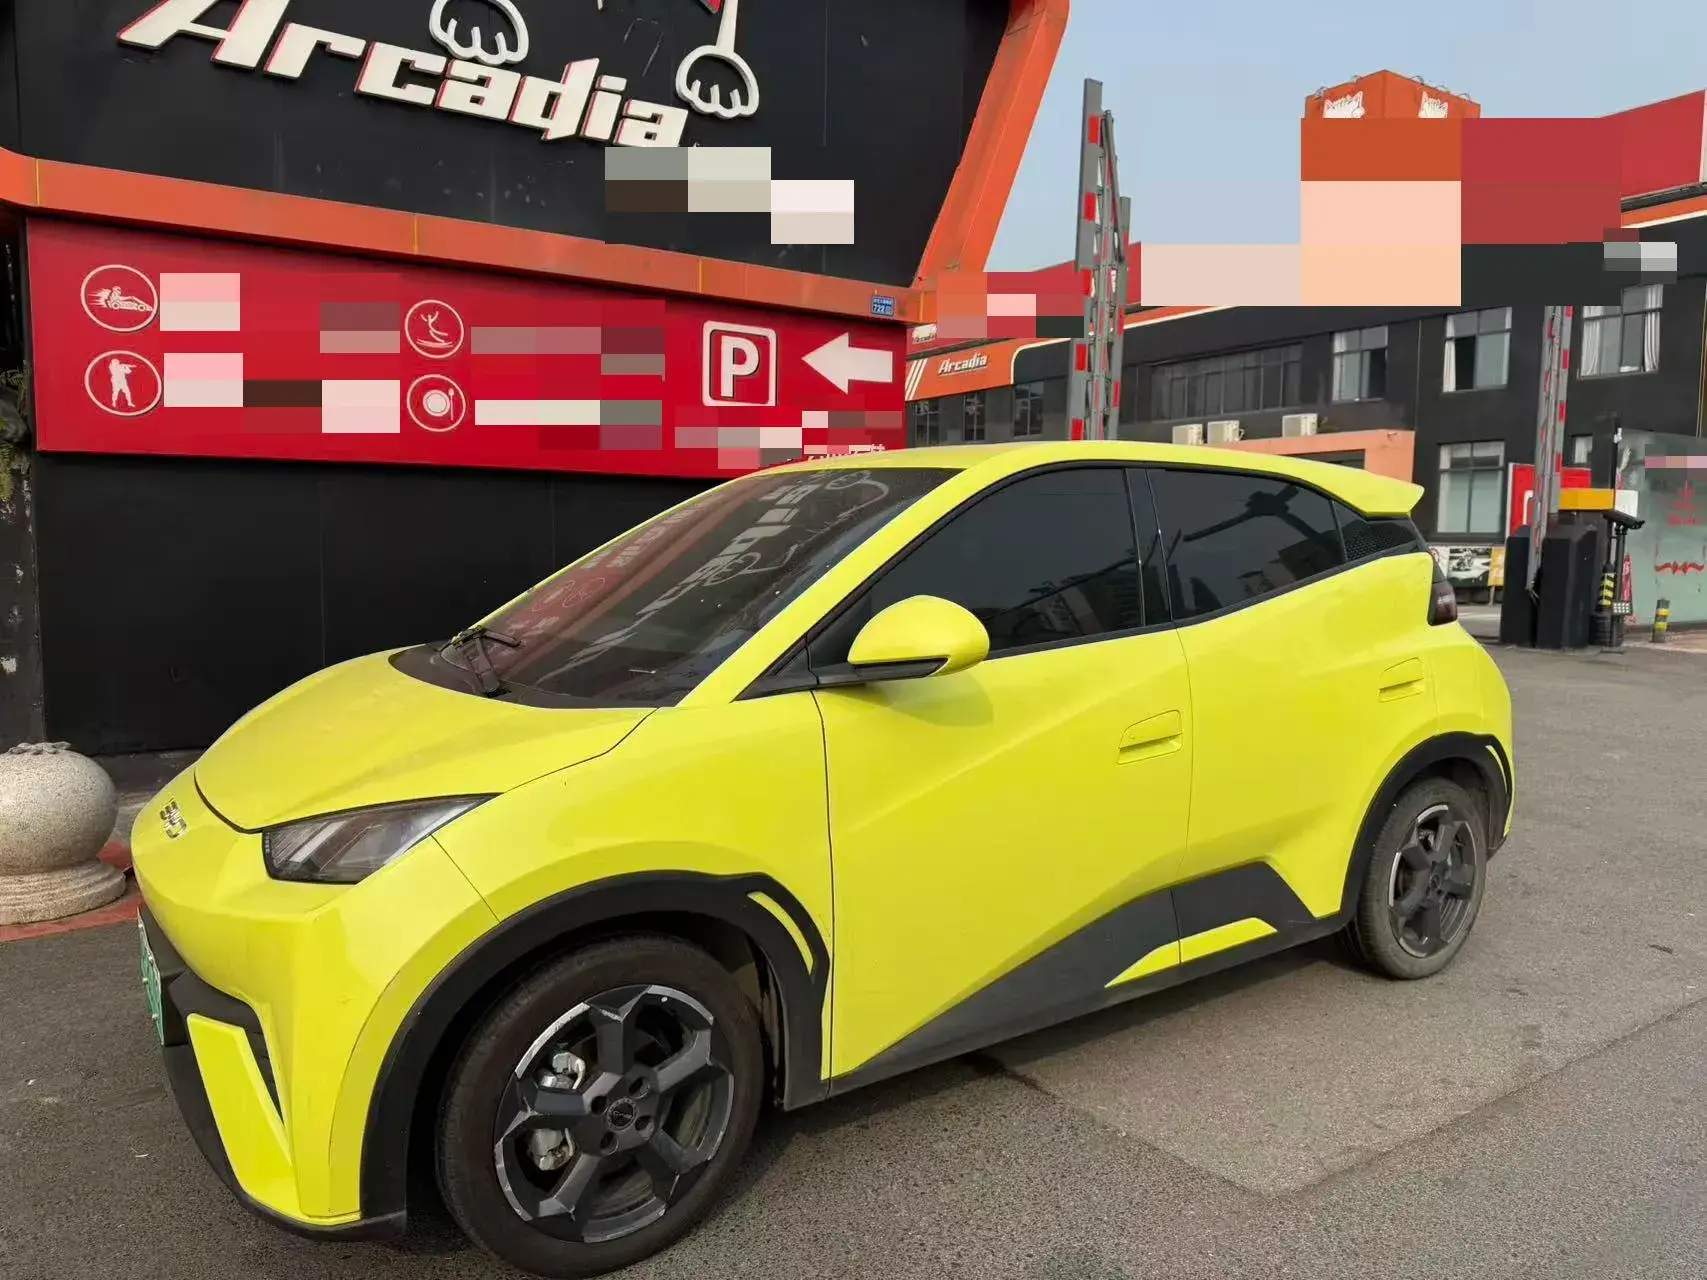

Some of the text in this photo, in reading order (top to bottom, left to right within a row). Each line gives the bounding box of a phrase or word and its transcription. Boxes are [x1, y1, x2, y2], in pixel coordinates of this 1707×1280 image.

[117, 0, 689, 147] Arcadia
[721, 335, 759, 397] P
[938, 353, 988, 374] Arcadia
